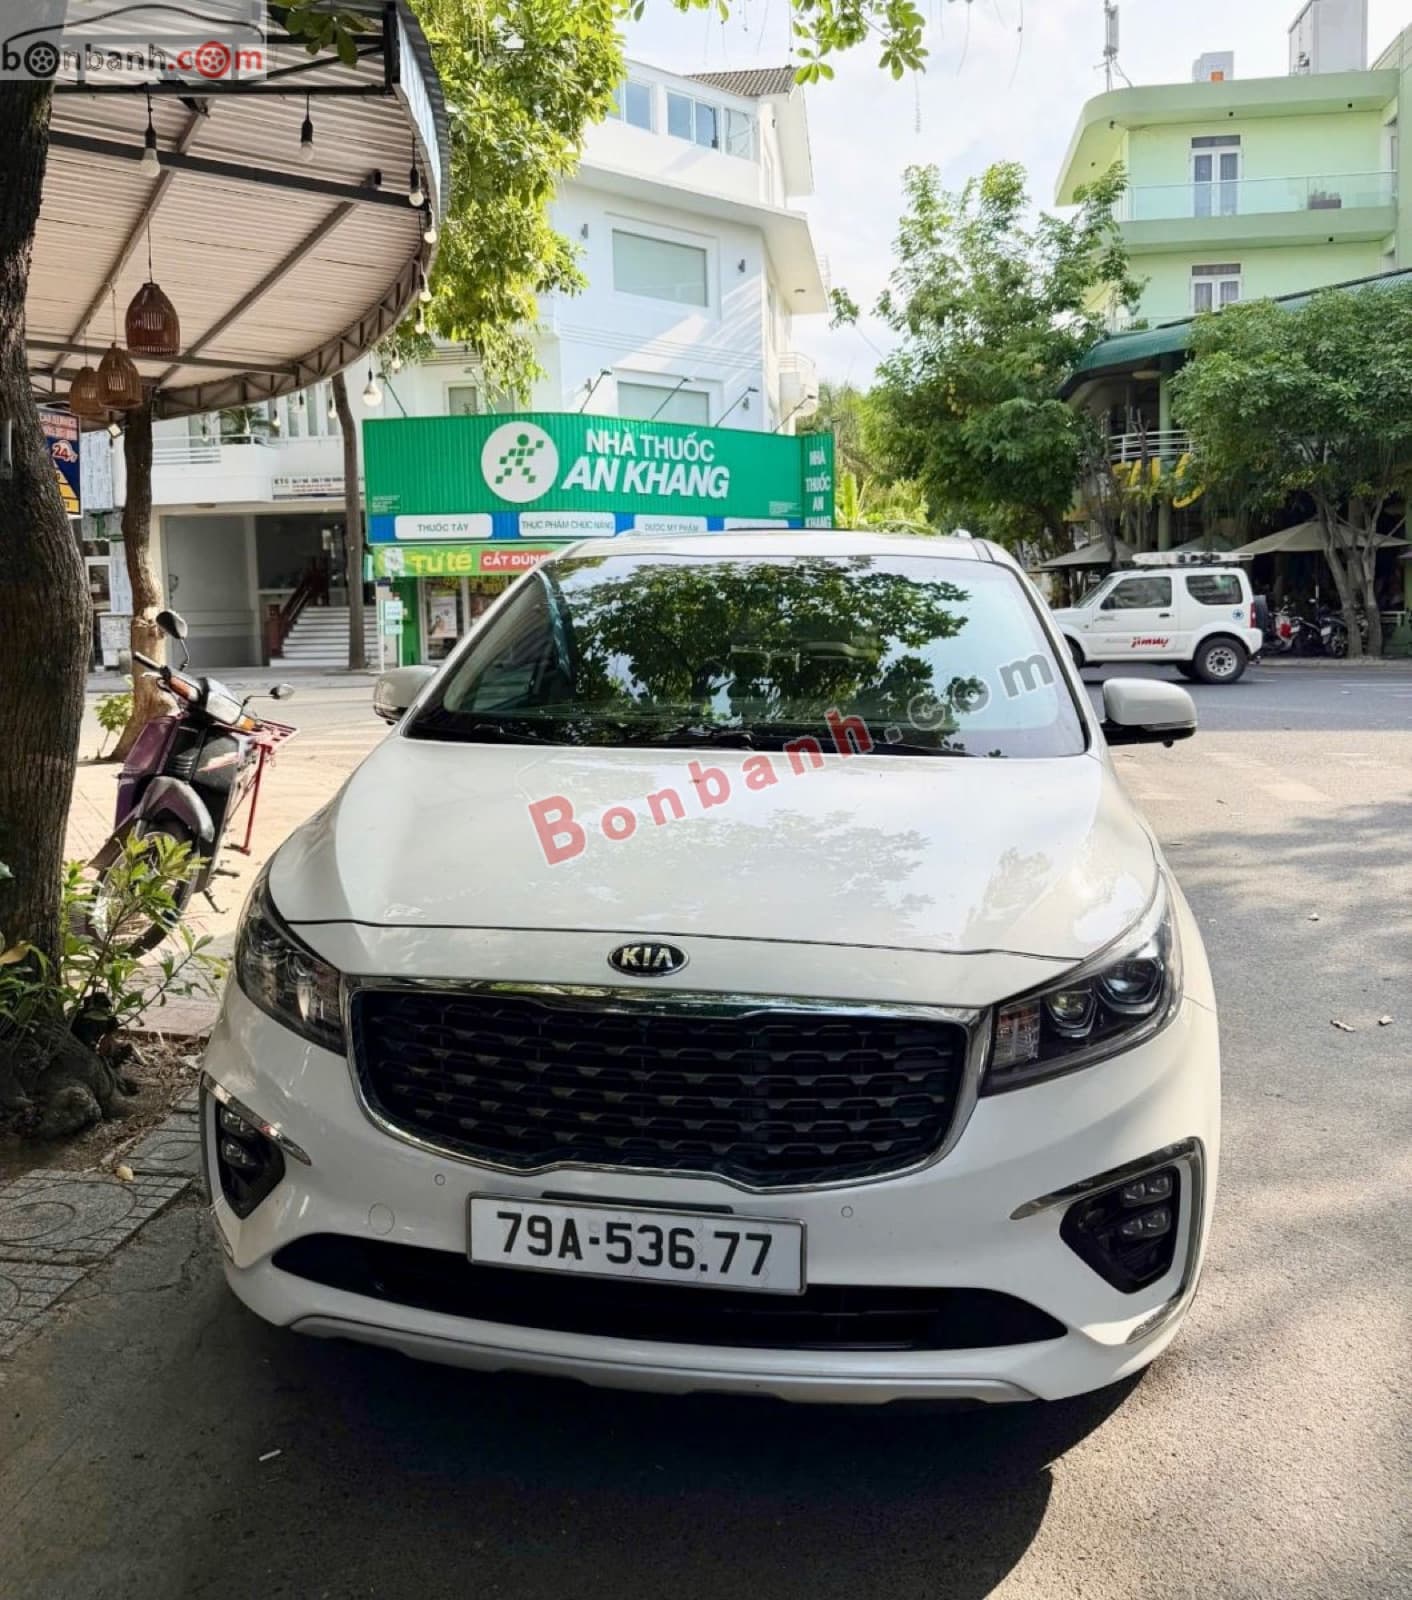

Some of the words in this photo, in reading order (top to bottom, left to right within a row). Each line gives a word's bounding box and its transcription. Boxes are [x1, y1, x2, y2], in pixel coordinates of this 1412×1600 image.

[586, 427, 637, 457] NHÀ
[639, 432, 716, 463] THUỐC
[562, 456, 621, 492] AN
[622, 460, 730, 499] KHANG
[812, 495, 825, 512] AN
[620, 946, 674, 968] KIA
[497, 1210, 773, 1276] 79A-536.77
